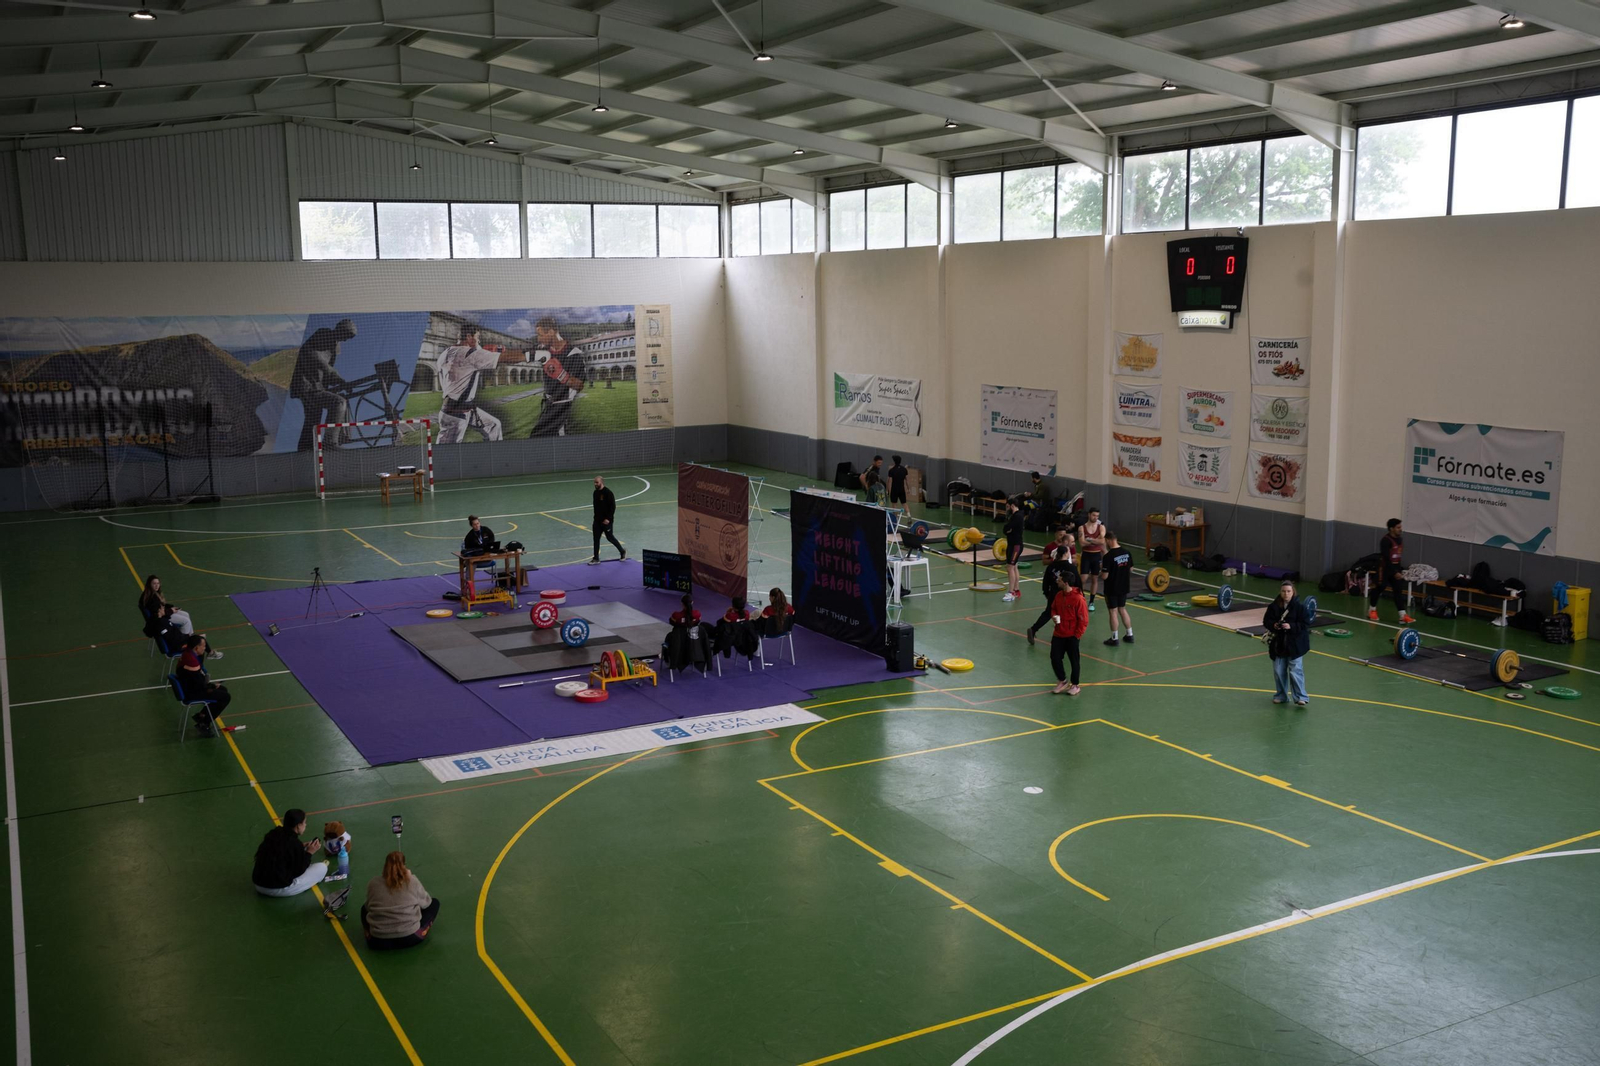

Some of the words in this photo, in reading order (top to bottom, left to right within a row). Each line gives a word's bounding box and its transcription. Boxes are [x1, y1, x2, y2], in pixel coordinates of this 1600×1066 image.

[1186, 257, 1195, 275] 0
[1226, 256, 1235, 274] 0
[1180, 315, 1218, 325] caixanova
[1257, 340, 1299, 349] CARNICERÍA
[1257, 350, 1267, 358] OS
[1268, 349, 1284, 358] FIÓS
[1, 381, 73, 393] TROFEO
[839, 383, 872, 403] Ramos
[878, 382, 893, 395] Super
[1118, 396, 1150, 407] LUINTRA
[1186, 391, 1226, 404] SUPERMERCADO
[1193, 398, 1217, 408] AURORA
[1275, 427, 1300, 436] REDONDO
[22, 437, 104, 450] RIBEIRA
[1427, 477, 1445, 486] Cursos
[1446, 480, 1470, 489] gratuitos
[1470, 484, 1514, 495] subvencionados
[1515, 488, 1533, 497] online
[685, 490, 742, 517] HALTEROFILIA
[1449, 494, 1461, 502] Algo
[1478, 498, 1507, 507] formación
[814, 550, 861, 575] LIFTING
[675, 580, 690, 590] 1:21
[814, 570, 861, 597] LEAGUE
[815, 606, 829, 616] LIFT
[831, 611, 848, 623] THAT
[850, 617, 860, 626] UP
[690, 716, 748, 730] XUNTA
[693, 726, 719, 735] DE
[721, 715, 793, 731] GALICIA
[491, 746, 557, 760] XUNTA
[497, 757, 523, 766] DE
[527, 745, 607, 761] GALICIA
